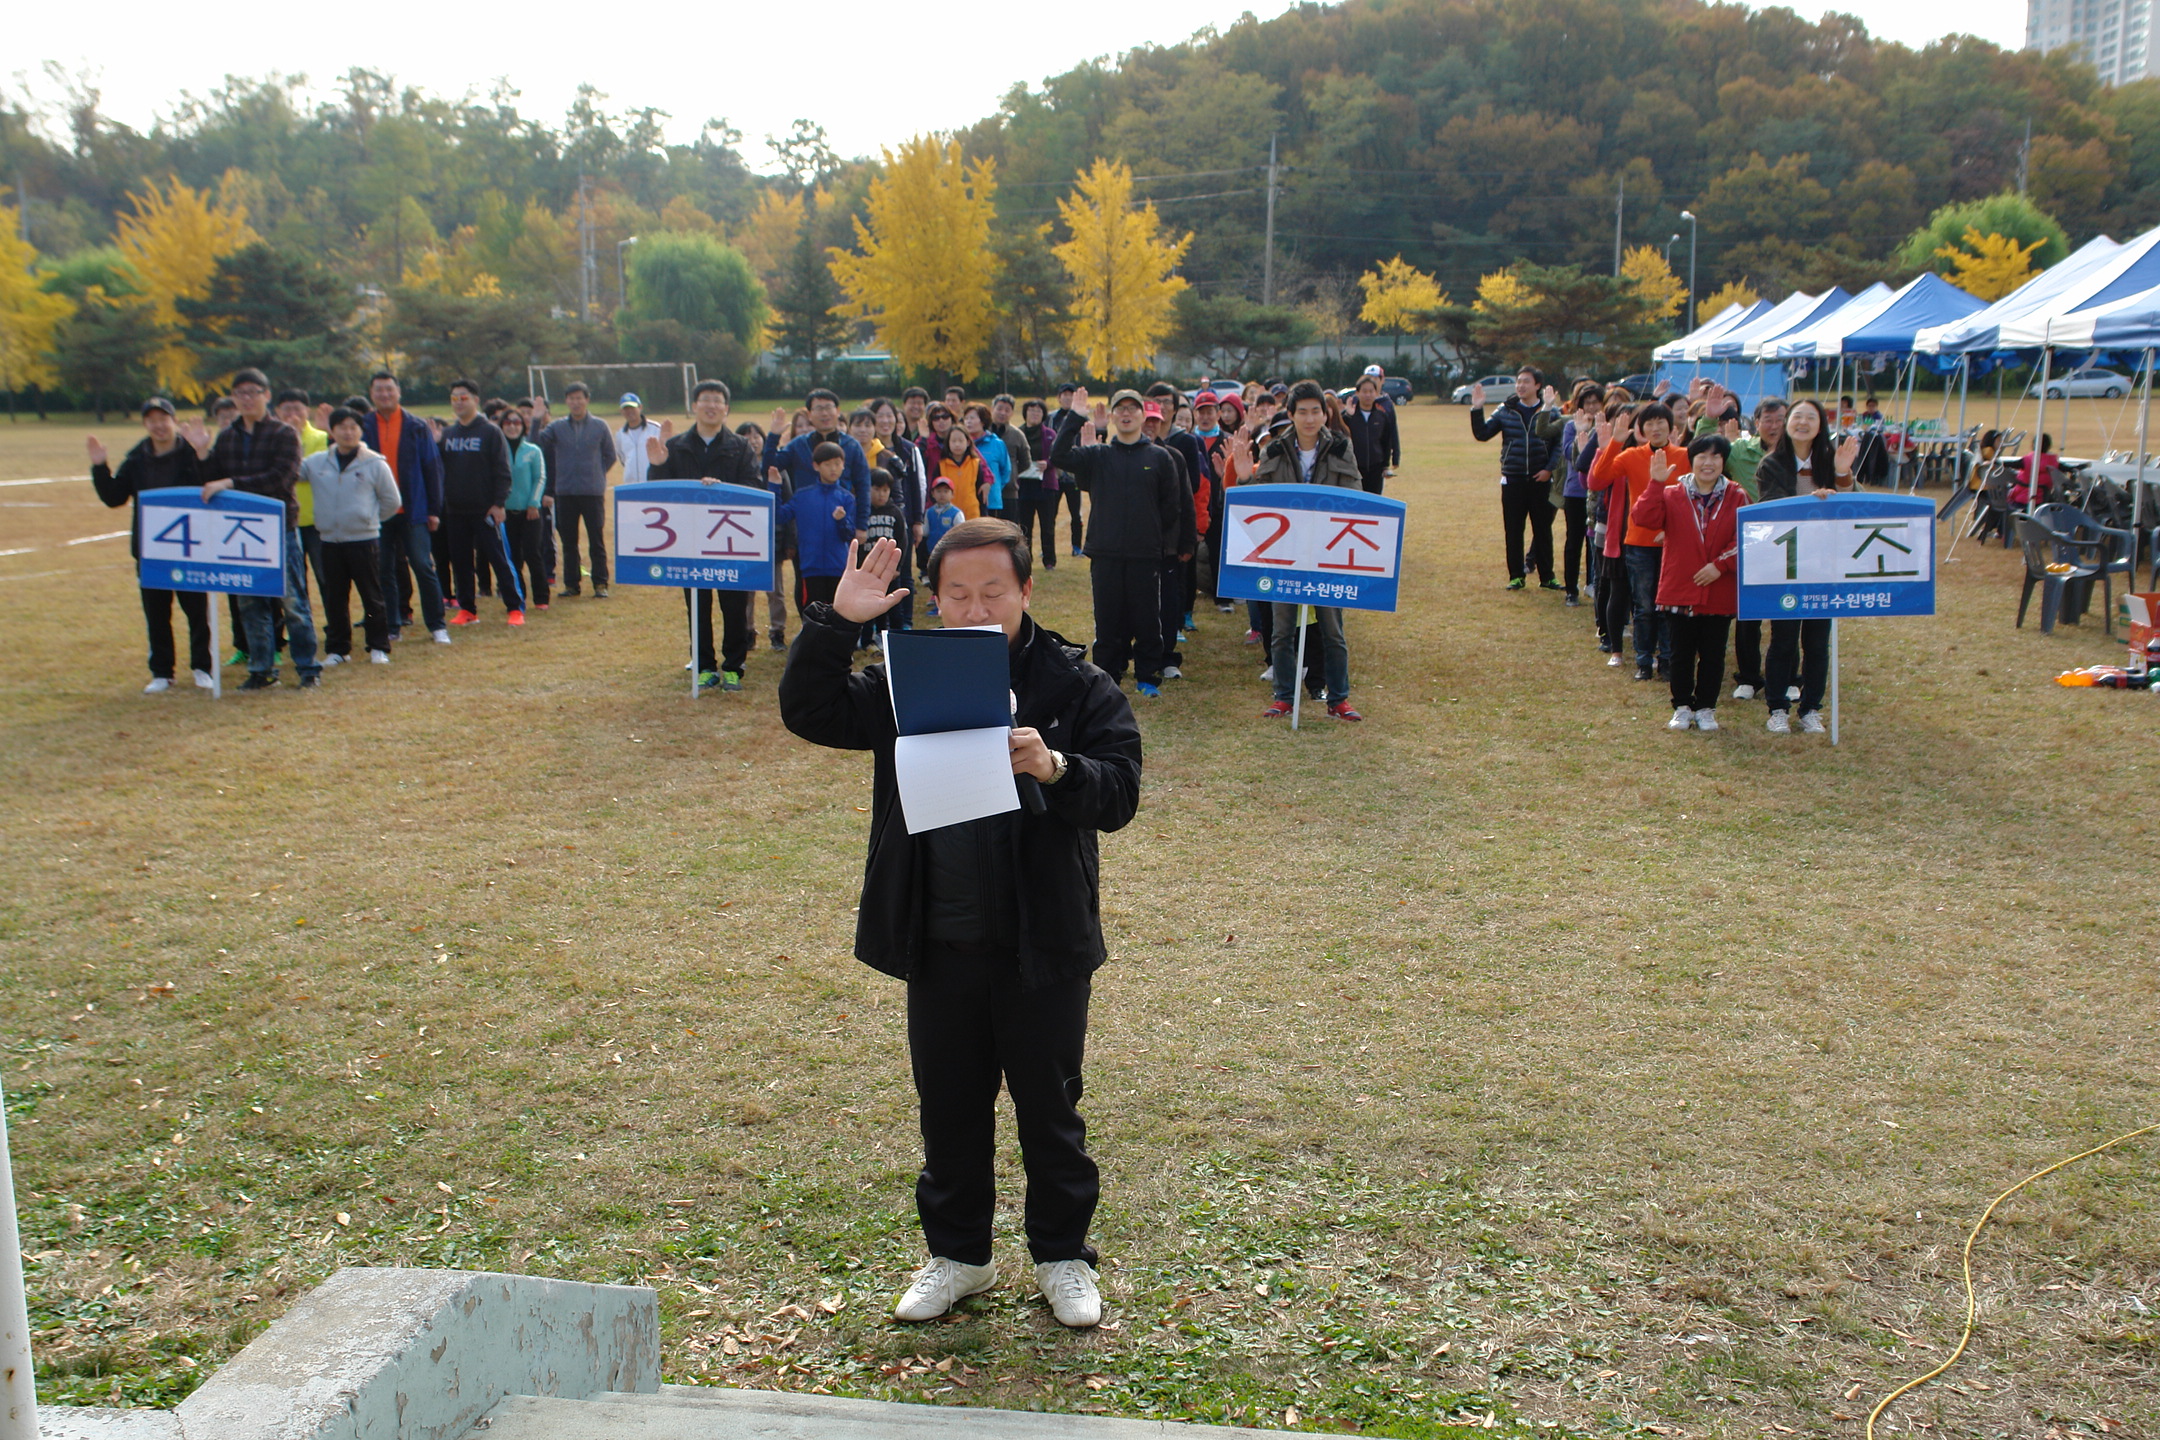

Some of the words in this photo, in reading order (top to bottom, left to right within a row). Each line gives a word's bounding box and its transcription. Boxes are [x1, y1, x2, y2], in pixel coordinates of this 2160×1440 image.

[445, 437, 481, 451] NIKE
[152, 513, 202, 558] 4
[217, 514, 272, 563] 조
[633, 506, 677, 553] 3
[701, 509, 761, 557] 조
[1241, 512, 1297, 566] 2
[1317, 516, 1385, 572] 조
[1773, 526, 1798, 580] 1
[1844, 522, 1920, 579] 조
[207, 572, 253, 588] 수원병원
[689, 567, 739, 583] 수원병원
[1276, 578, 1302, 588] 경기도립
[1302, 581, 1359, 600] 수원병원
[1829, 592, 1891, 609] 수원병원
